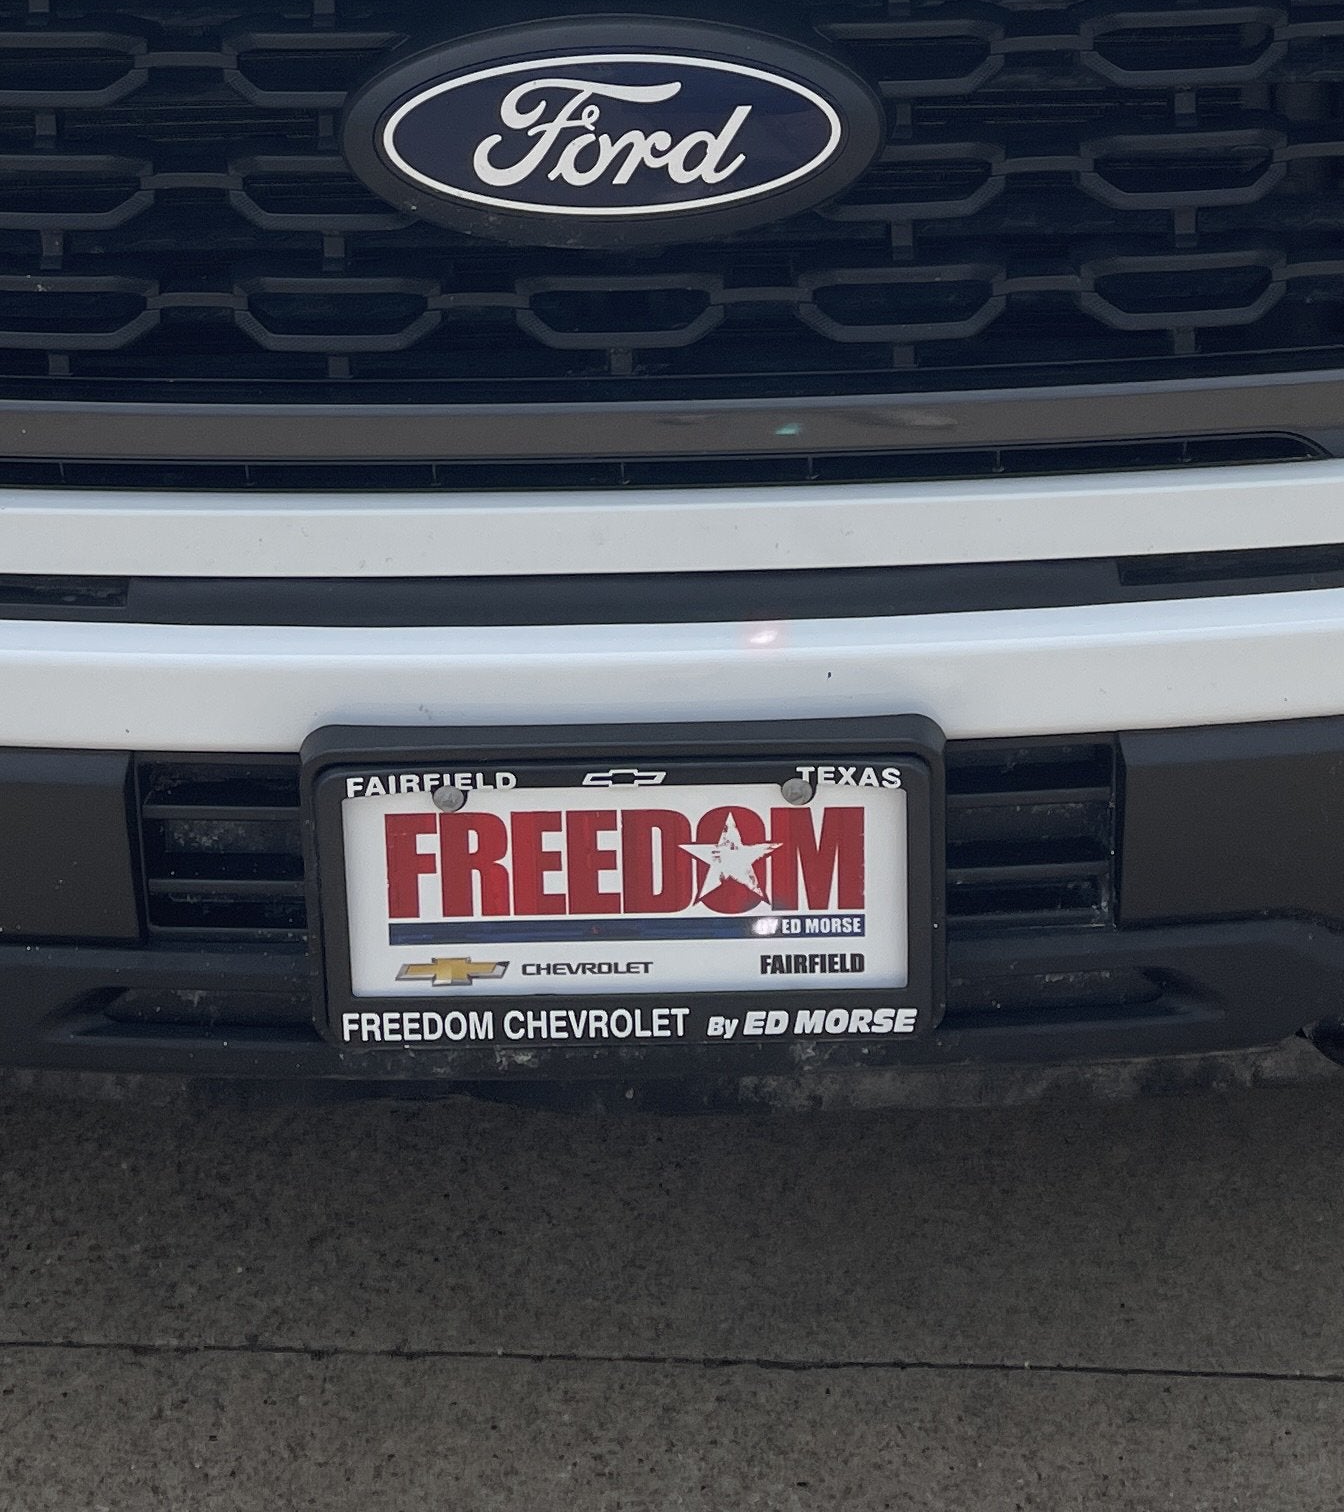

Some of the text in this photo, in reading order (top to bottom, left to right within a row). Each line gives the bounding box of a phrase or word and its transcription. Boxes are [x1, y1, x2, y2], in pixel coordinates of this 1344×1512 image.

[473, 78, 751, 187] Ford
[346, 766, 902, 798] FAIRFIELD TEXAS
[384, 806, 864, 919] FREEDOM
[781, 918, 801, 934] ED
[805, 917, 862, 934] MORSE
[521, 961, 654, 976] CHEVROLET
[760, 953, 865, 975] FAIRFIELD
[342, 1008, 918, 1041] FREEDOM CHEVROLET By ED MORSE
